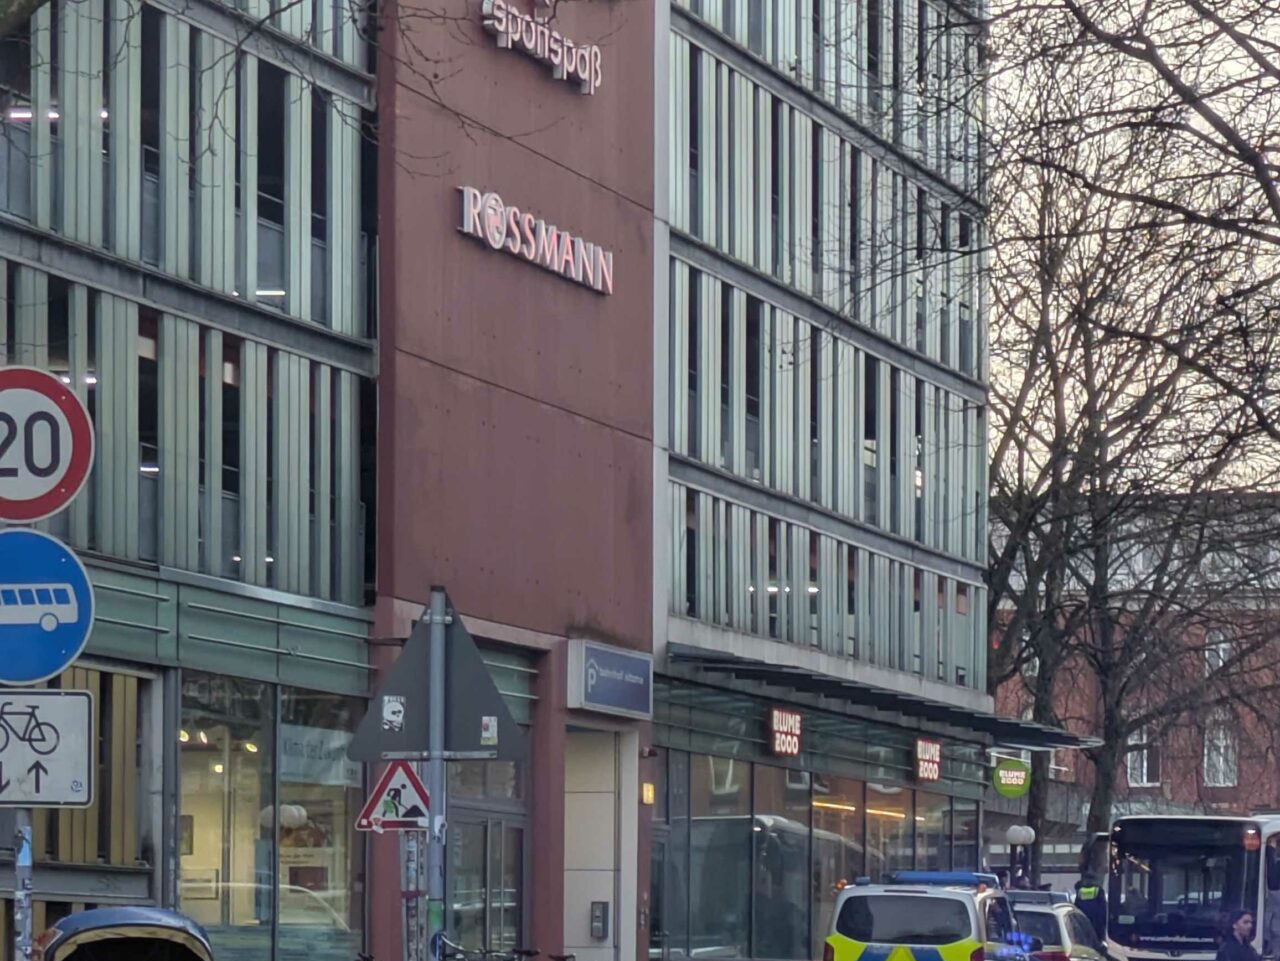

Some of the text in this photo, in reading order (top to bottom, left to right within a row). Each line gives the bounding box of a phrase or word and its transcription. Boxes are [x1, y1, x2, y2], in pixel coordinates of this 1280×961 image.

[460, 186, 613, 295] ROSSMANN
[772, 709, 802, 736] BLUME
[774, 734, 800, 755] 2000
[917, 739, 941, 763] BLUME
[918, 760, 939, 780] 2000
